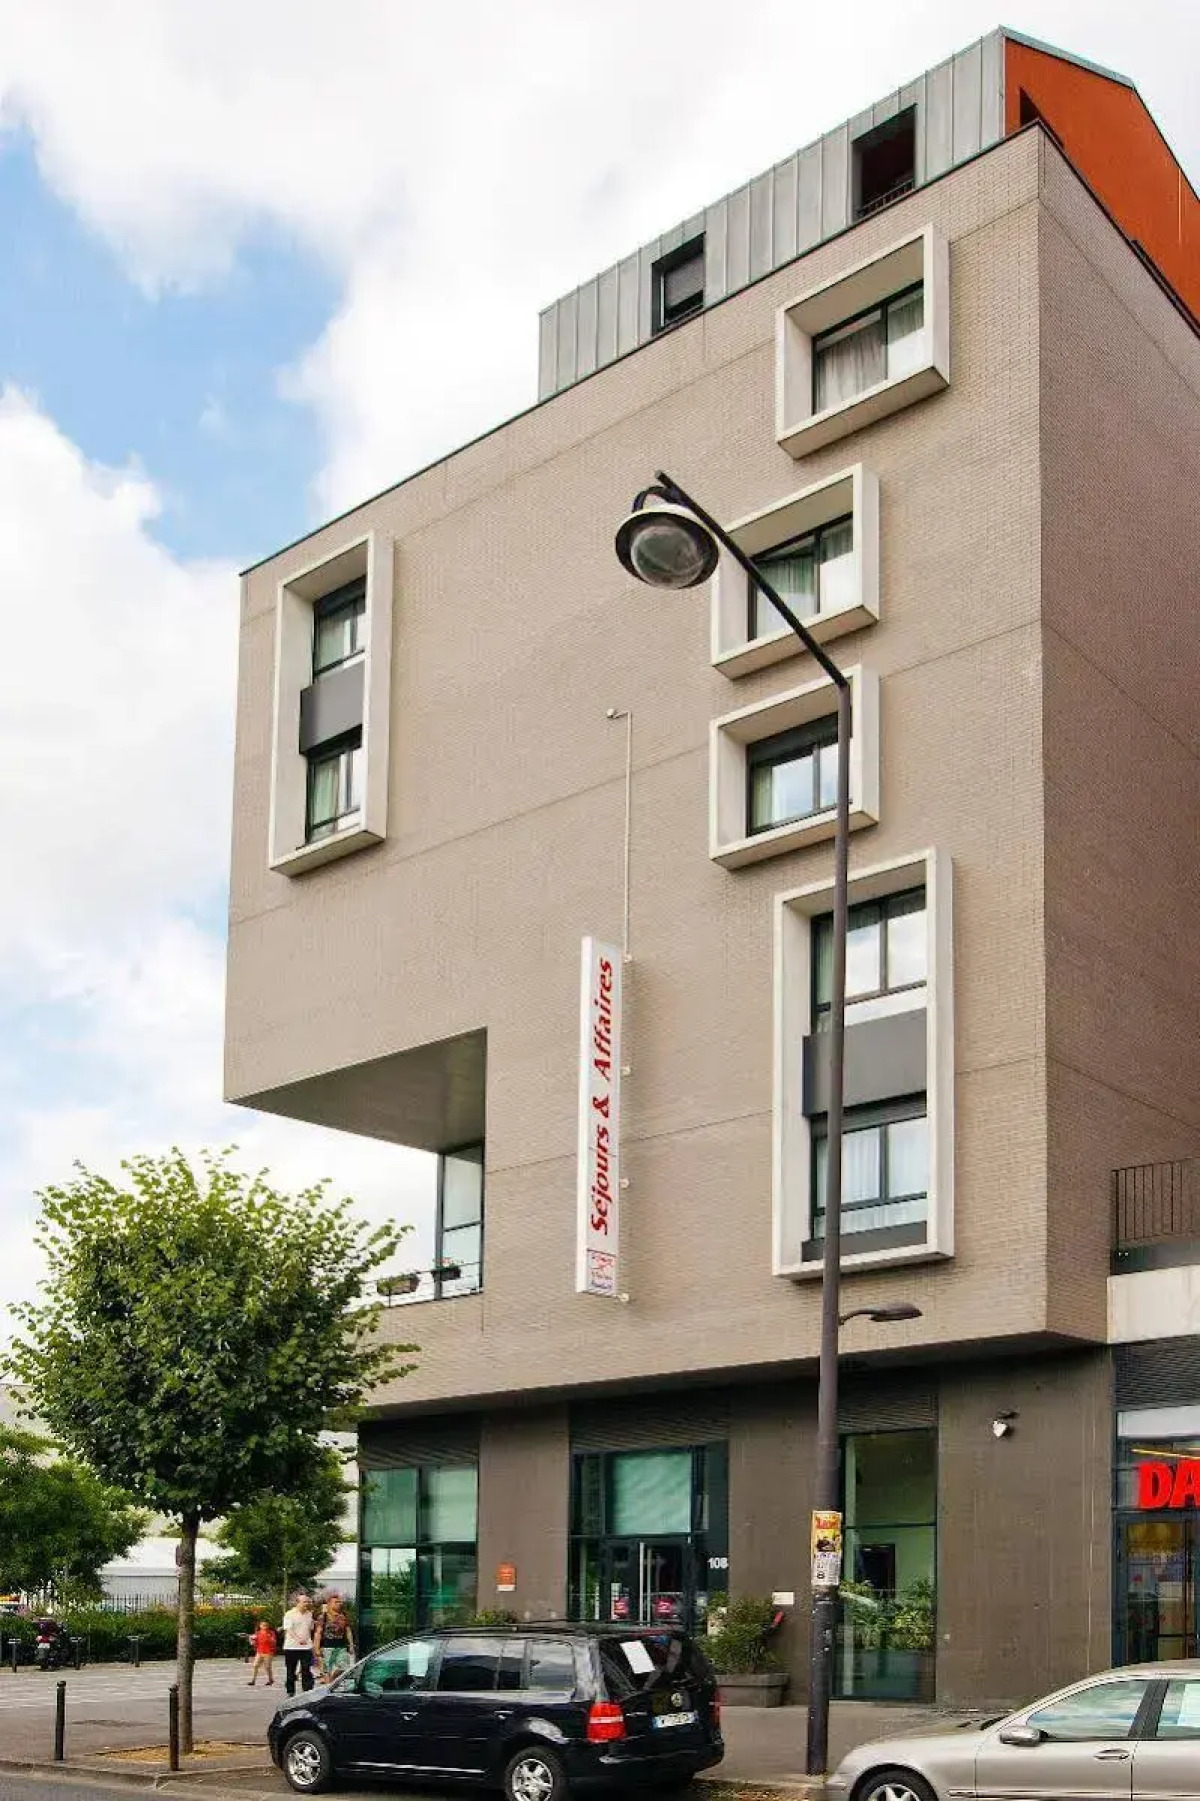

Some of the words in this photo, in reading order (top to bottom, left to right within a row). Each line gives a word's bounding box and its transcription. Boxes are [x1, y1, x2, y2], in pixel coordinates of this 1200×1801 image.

[594, 957, 614, 1082] Affaires
[592, 1094, 610, 1119] &
[591, 1124, 613, 1236] Séjours
